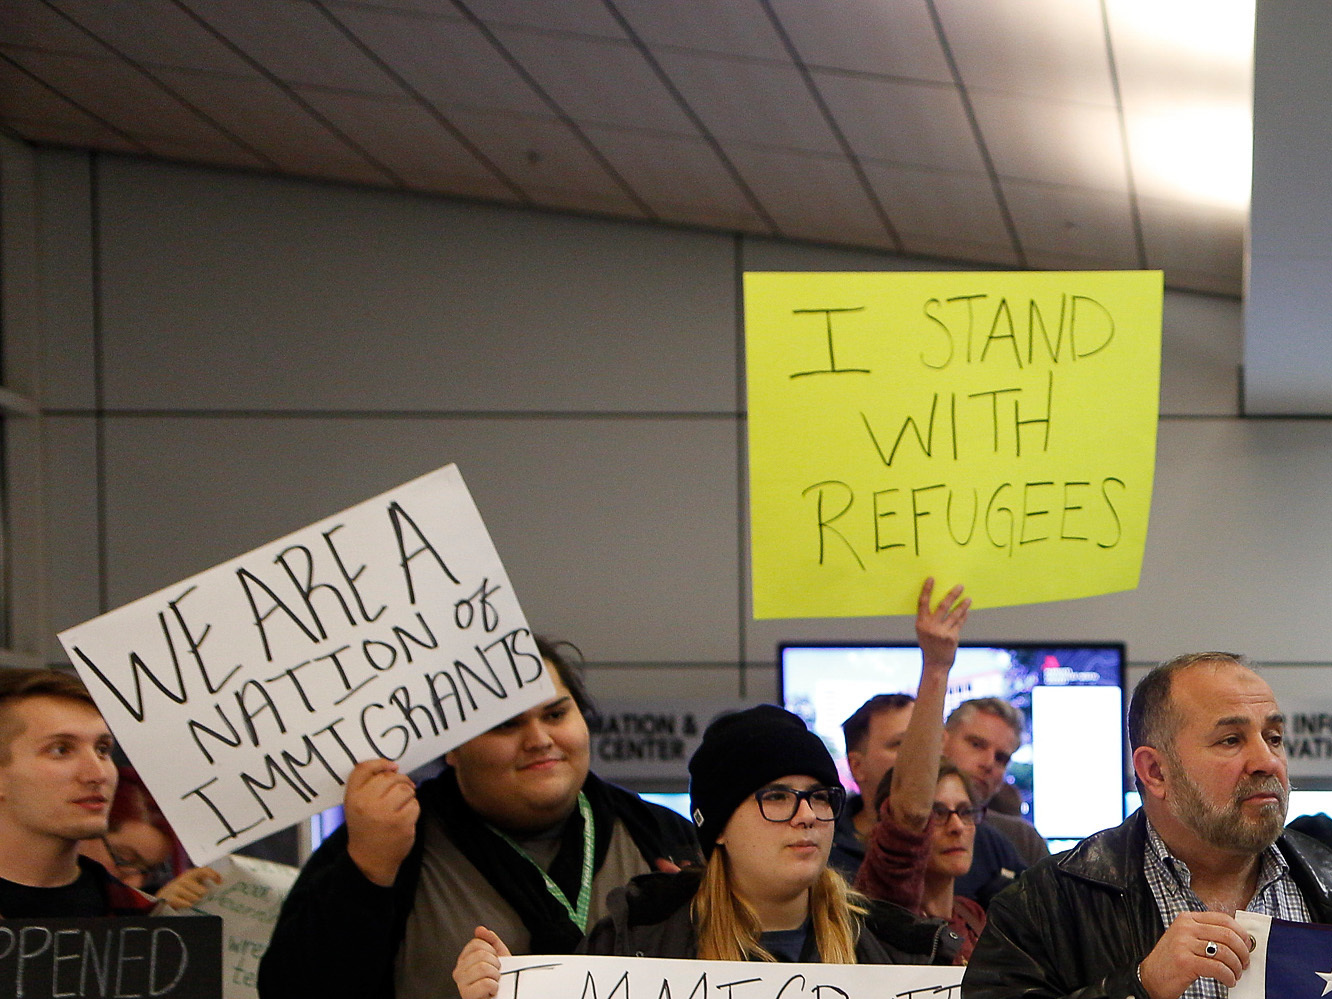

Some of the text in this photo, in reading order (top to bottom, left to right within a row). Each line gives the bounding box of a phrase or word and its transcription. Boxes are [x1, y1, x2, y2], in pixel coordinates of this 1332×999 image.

[790, 292, 1116, 379] I STAND
[859, 370, 1054, 467] WITH
[801, 476, 1126, 571] REFUGEES
[73, 500, 460, 724] WE ARE A
[180, 627, 545, 846] IMMIGRANTS
[186, 611, 439, 765] NATION
[599, 736, 686, 761] CENTER
